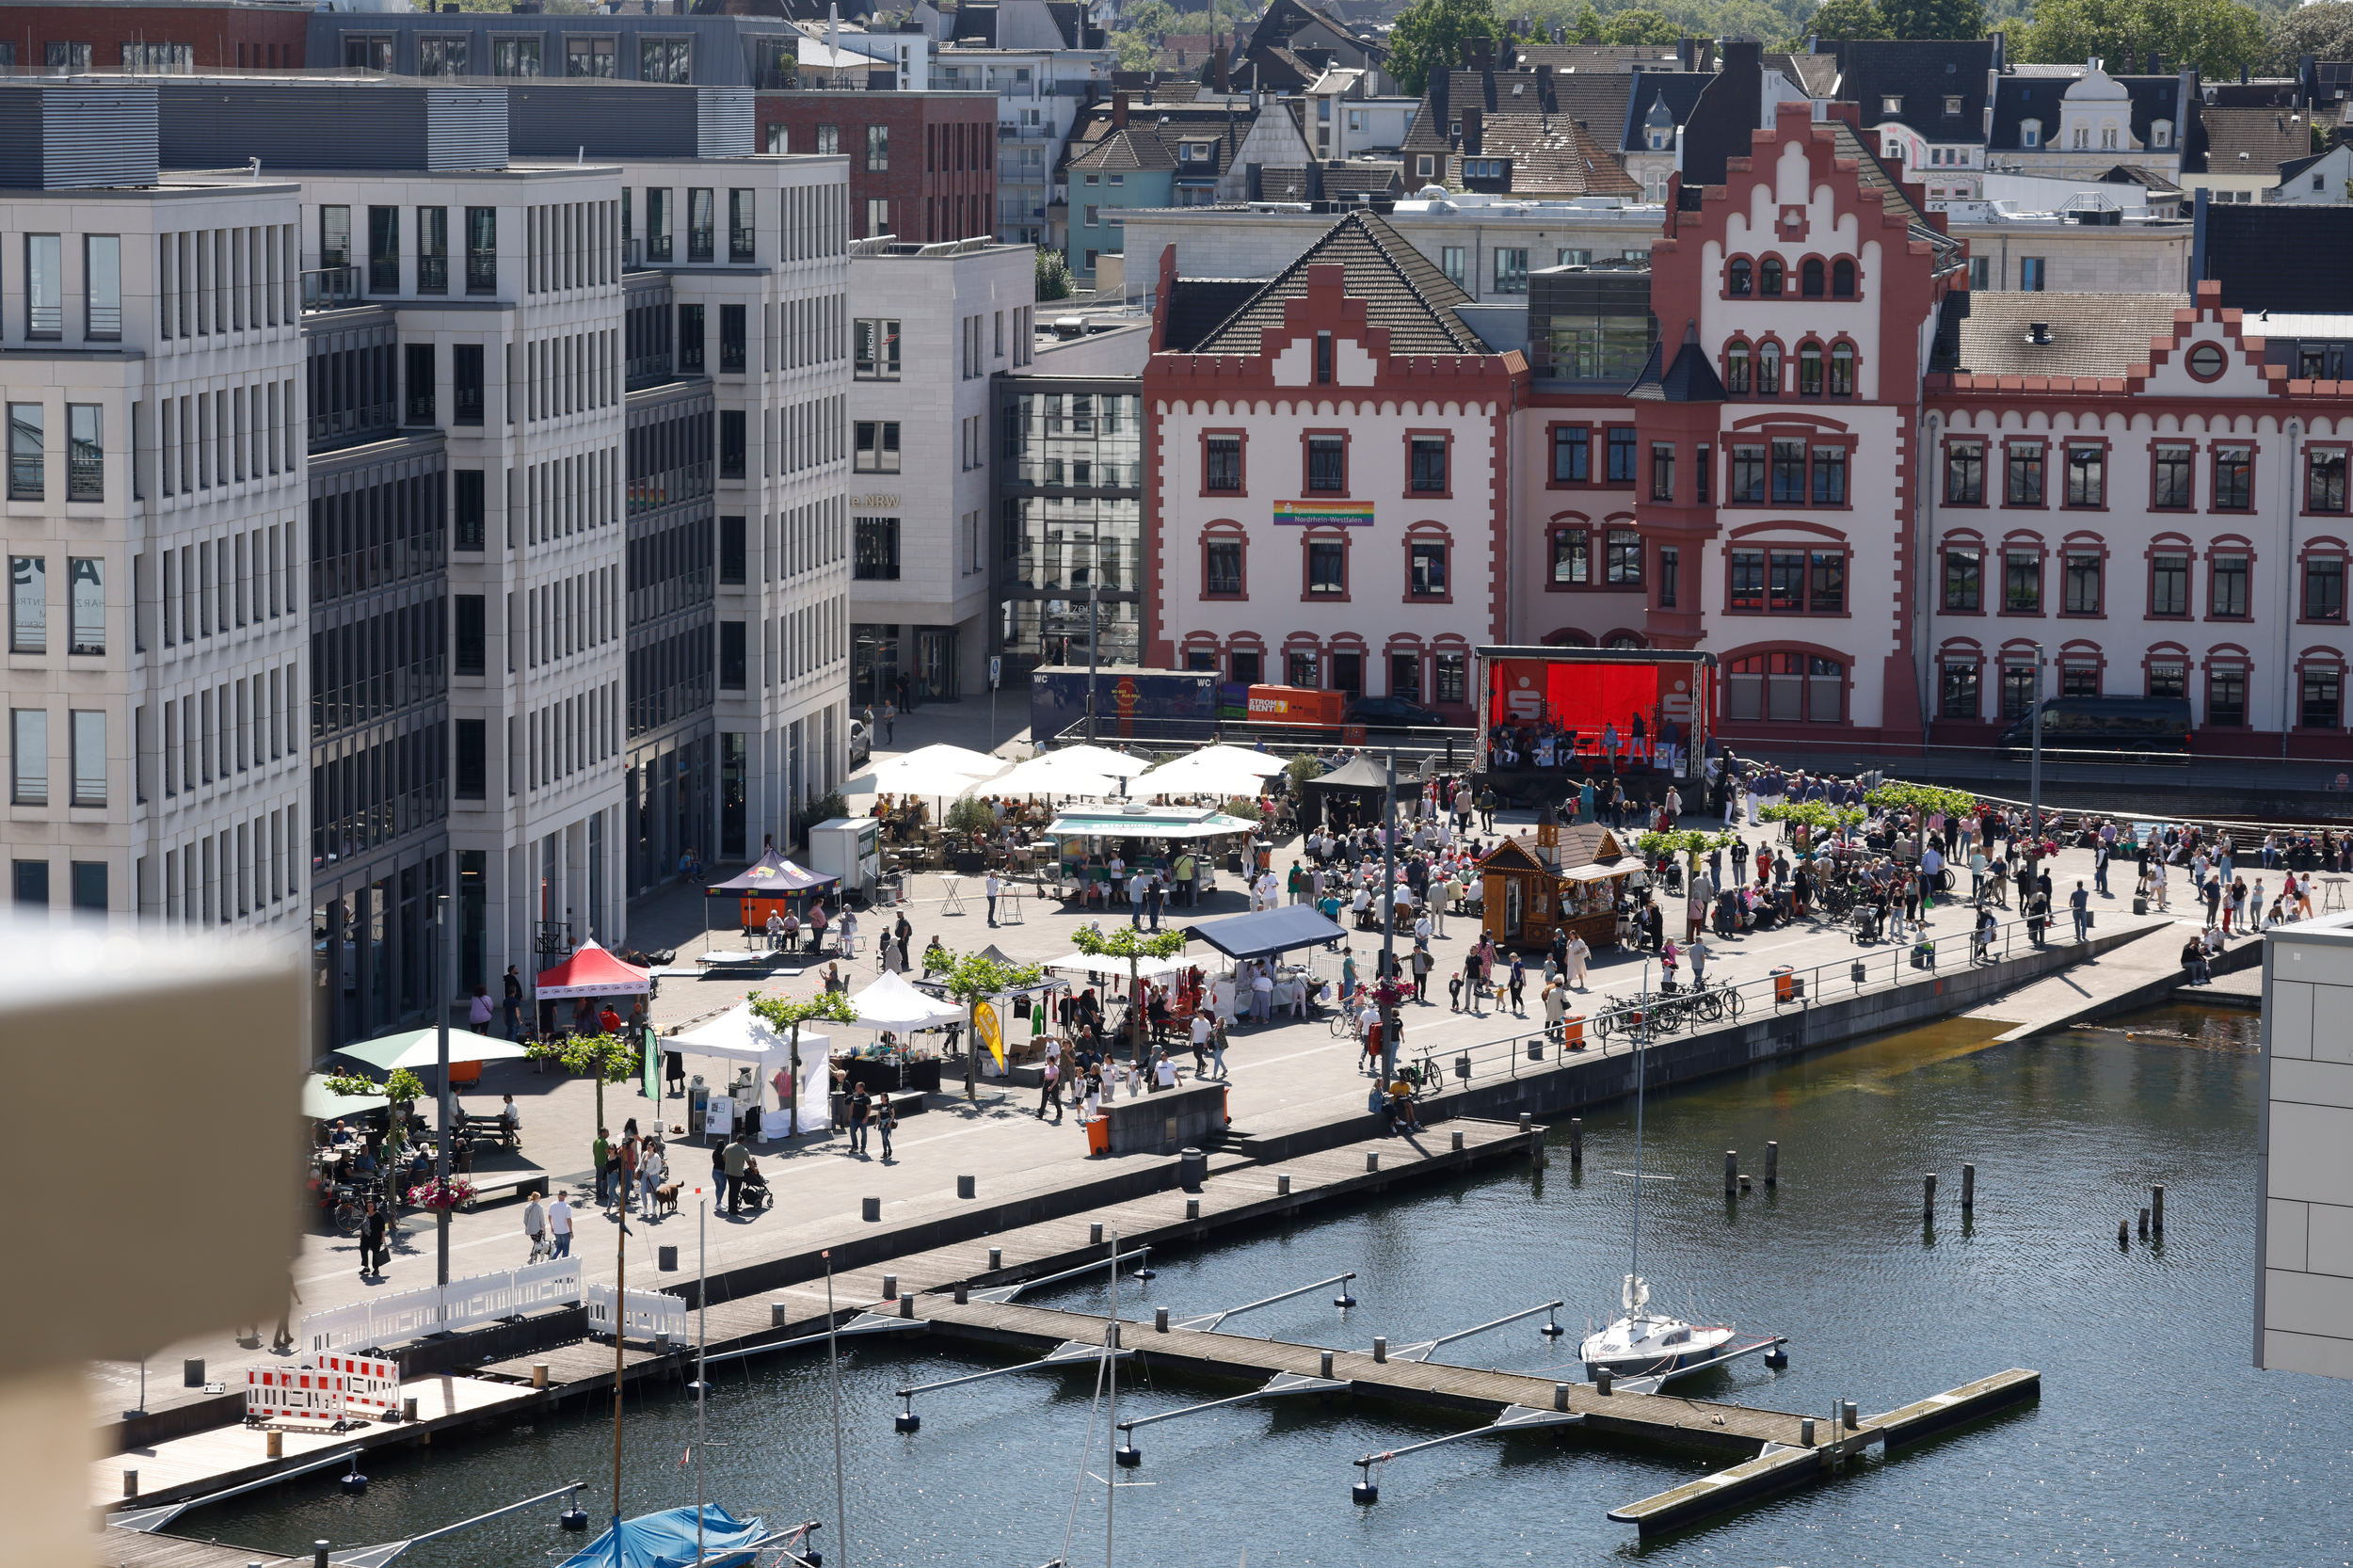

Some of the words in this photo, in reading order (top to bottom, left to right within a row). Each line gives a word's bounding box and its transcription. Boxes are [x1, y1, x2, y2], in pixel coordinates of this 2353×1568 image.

[865, 495, 900, 508] NRW
[1294, 515, 1363, 523] Nordrhein-Westfalen
[1033, 675, 1048, 683] WC
[1197, 679, 1211, 687] WC
[1249, 698, 1277, 707] STROM
[1249, 704, 1273, 712] RENT
